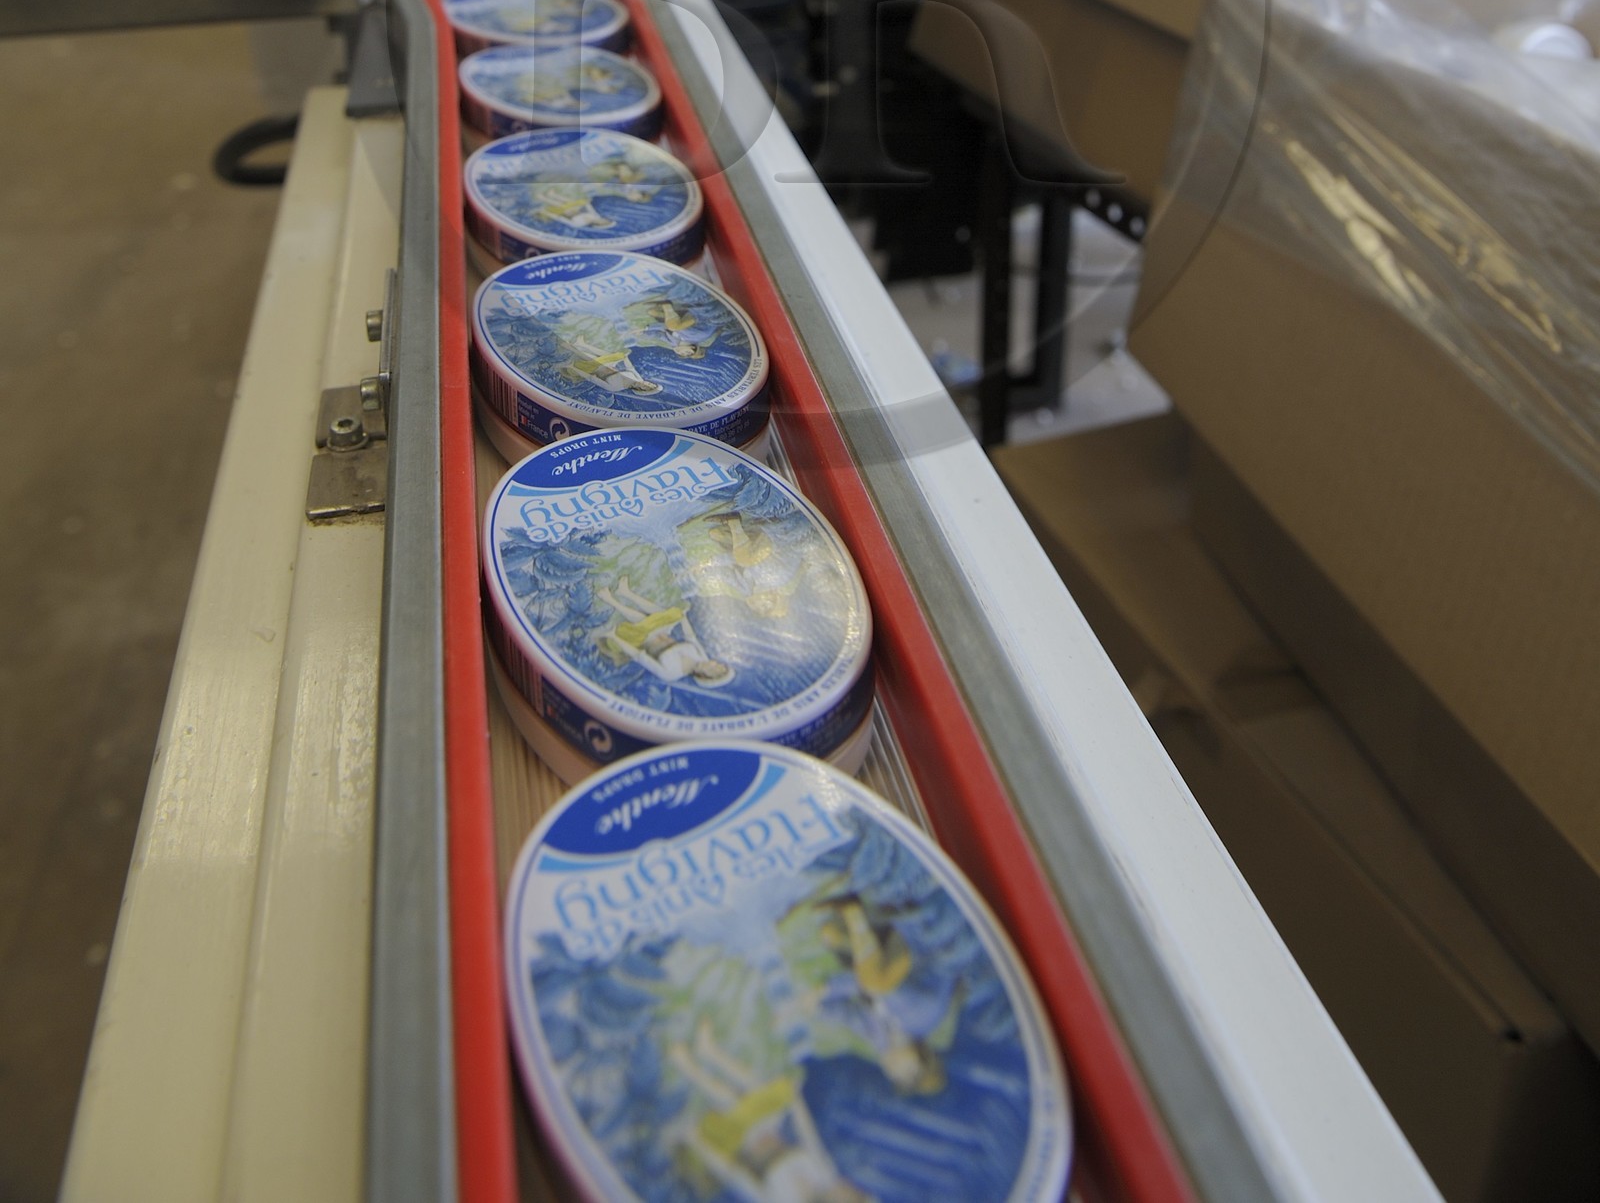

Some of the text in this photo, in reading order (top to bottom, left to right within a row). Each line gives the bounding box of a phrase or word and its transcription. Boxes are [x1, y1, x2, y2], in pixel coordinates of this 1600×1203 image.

[525, 261, 597, 280] Menthe
[499, 269, 668, 310] Flavigny
[567, 400, 613, 417] FLAVIGNY
[635, 410, 686, 419] L'ABBAYE
[689, 405, 702, 415] DE
[705, 397, 726, 409] ANIS
[527, 419, 548, 438] France
[549, 434, 622, 458] MINT DROPS
[551, 445, 643, 477] Menthe
[519, 456, 733, 528] Flavigny
[573, 498, 644, 530] Anis
[530, 520, 568, 542] de
[791, 685, 821, 710] ANIS
[607, 700, 672, 728] FLAVIGNY
[699, 714, 768, 733] L'ABBAYE
[769, 706, 790, 720] DE
[678, 720, 692, 732] DE
[590, 756, 689, 803] MINT DROPS
[595, 773, 719, 835] Menthe
[554, 794, 840, 929] Flavigny
[629, 875, 726, 932] Anis
[570, 918, 623, 953] de
